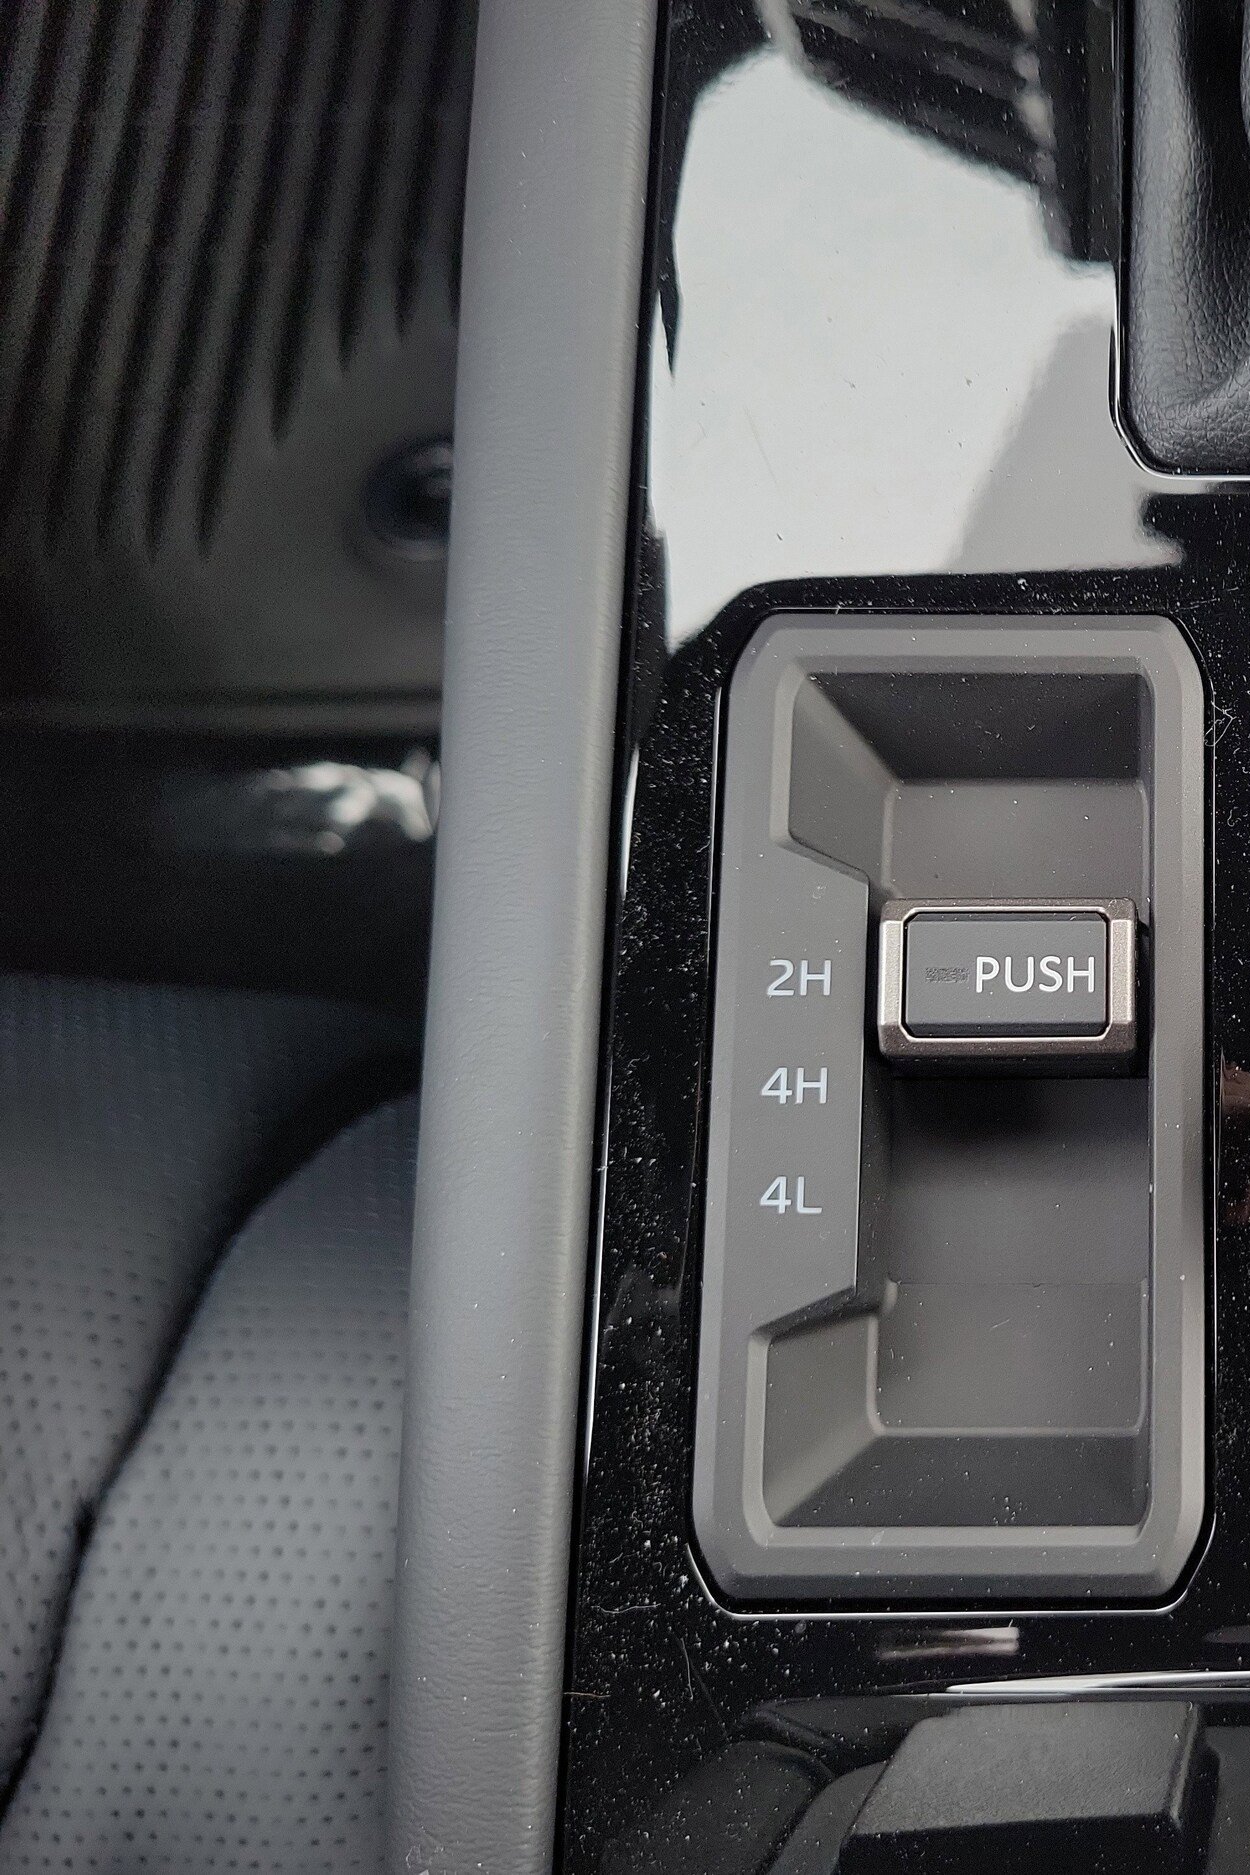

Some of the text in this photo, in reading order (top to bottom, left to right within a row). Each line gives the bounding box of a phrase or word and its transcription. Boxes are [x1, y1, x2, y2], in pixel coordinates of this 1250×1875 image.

[766, 959, 832, 997] 2H
[975, 955, 1095, 993] PUSH
[760, 1067, 828, 1105] 4H
[759, 1176, 823, 1214] 4L
